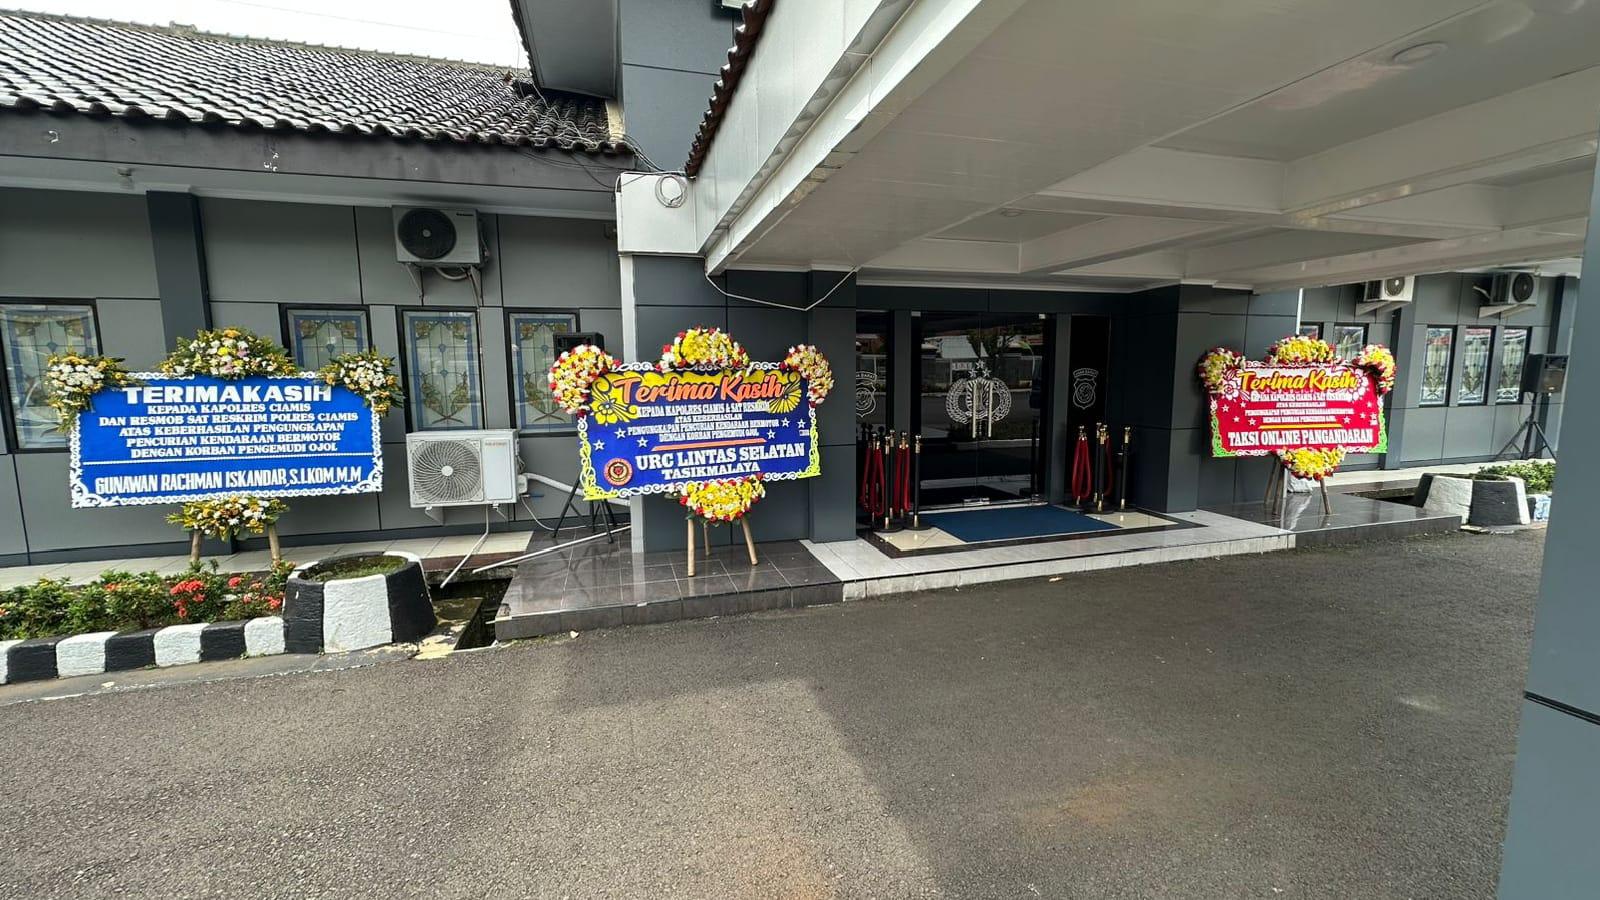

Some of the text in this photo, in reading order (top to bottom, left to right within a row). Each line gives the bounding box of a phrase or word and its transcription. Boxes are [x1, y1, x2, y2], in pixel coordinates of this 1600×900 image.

[613, 374, 785, 404] Terima Kasih
[1239, 370, 1358, 392] Terima Kasih
[122, 385, 332, 404] TERIMAKASIH
[148, 403, 312, 415] KEPADA KAPOLRES CIAMIS
[665, 404, 702, 417] KAPOLRES
[99, 412, 359, 427] DAN RESMOB SAT RESKRIM POLRES CIAMIS
[119, 422, 345, 438] ATAS KEBERHASILAN PENGUNGKAPAN
[1228, 428, 1374, 447] TAKSI ONLINE PANGANDARAN
[126, 432, 341, 448] PENCURIAN KENDARAAN BERMOTOR
[131, 442, 338, 458] DENGAN KORBAN PENGEMUDI OJOL
[635, 442, 805, 471] URC LINTAS SELATAN
[661, 462, 761, 480] TASIKMALAYA
[95, 474, 158, 495] GUNAWAN
[160, 471, 223, 493] RACHMAN
